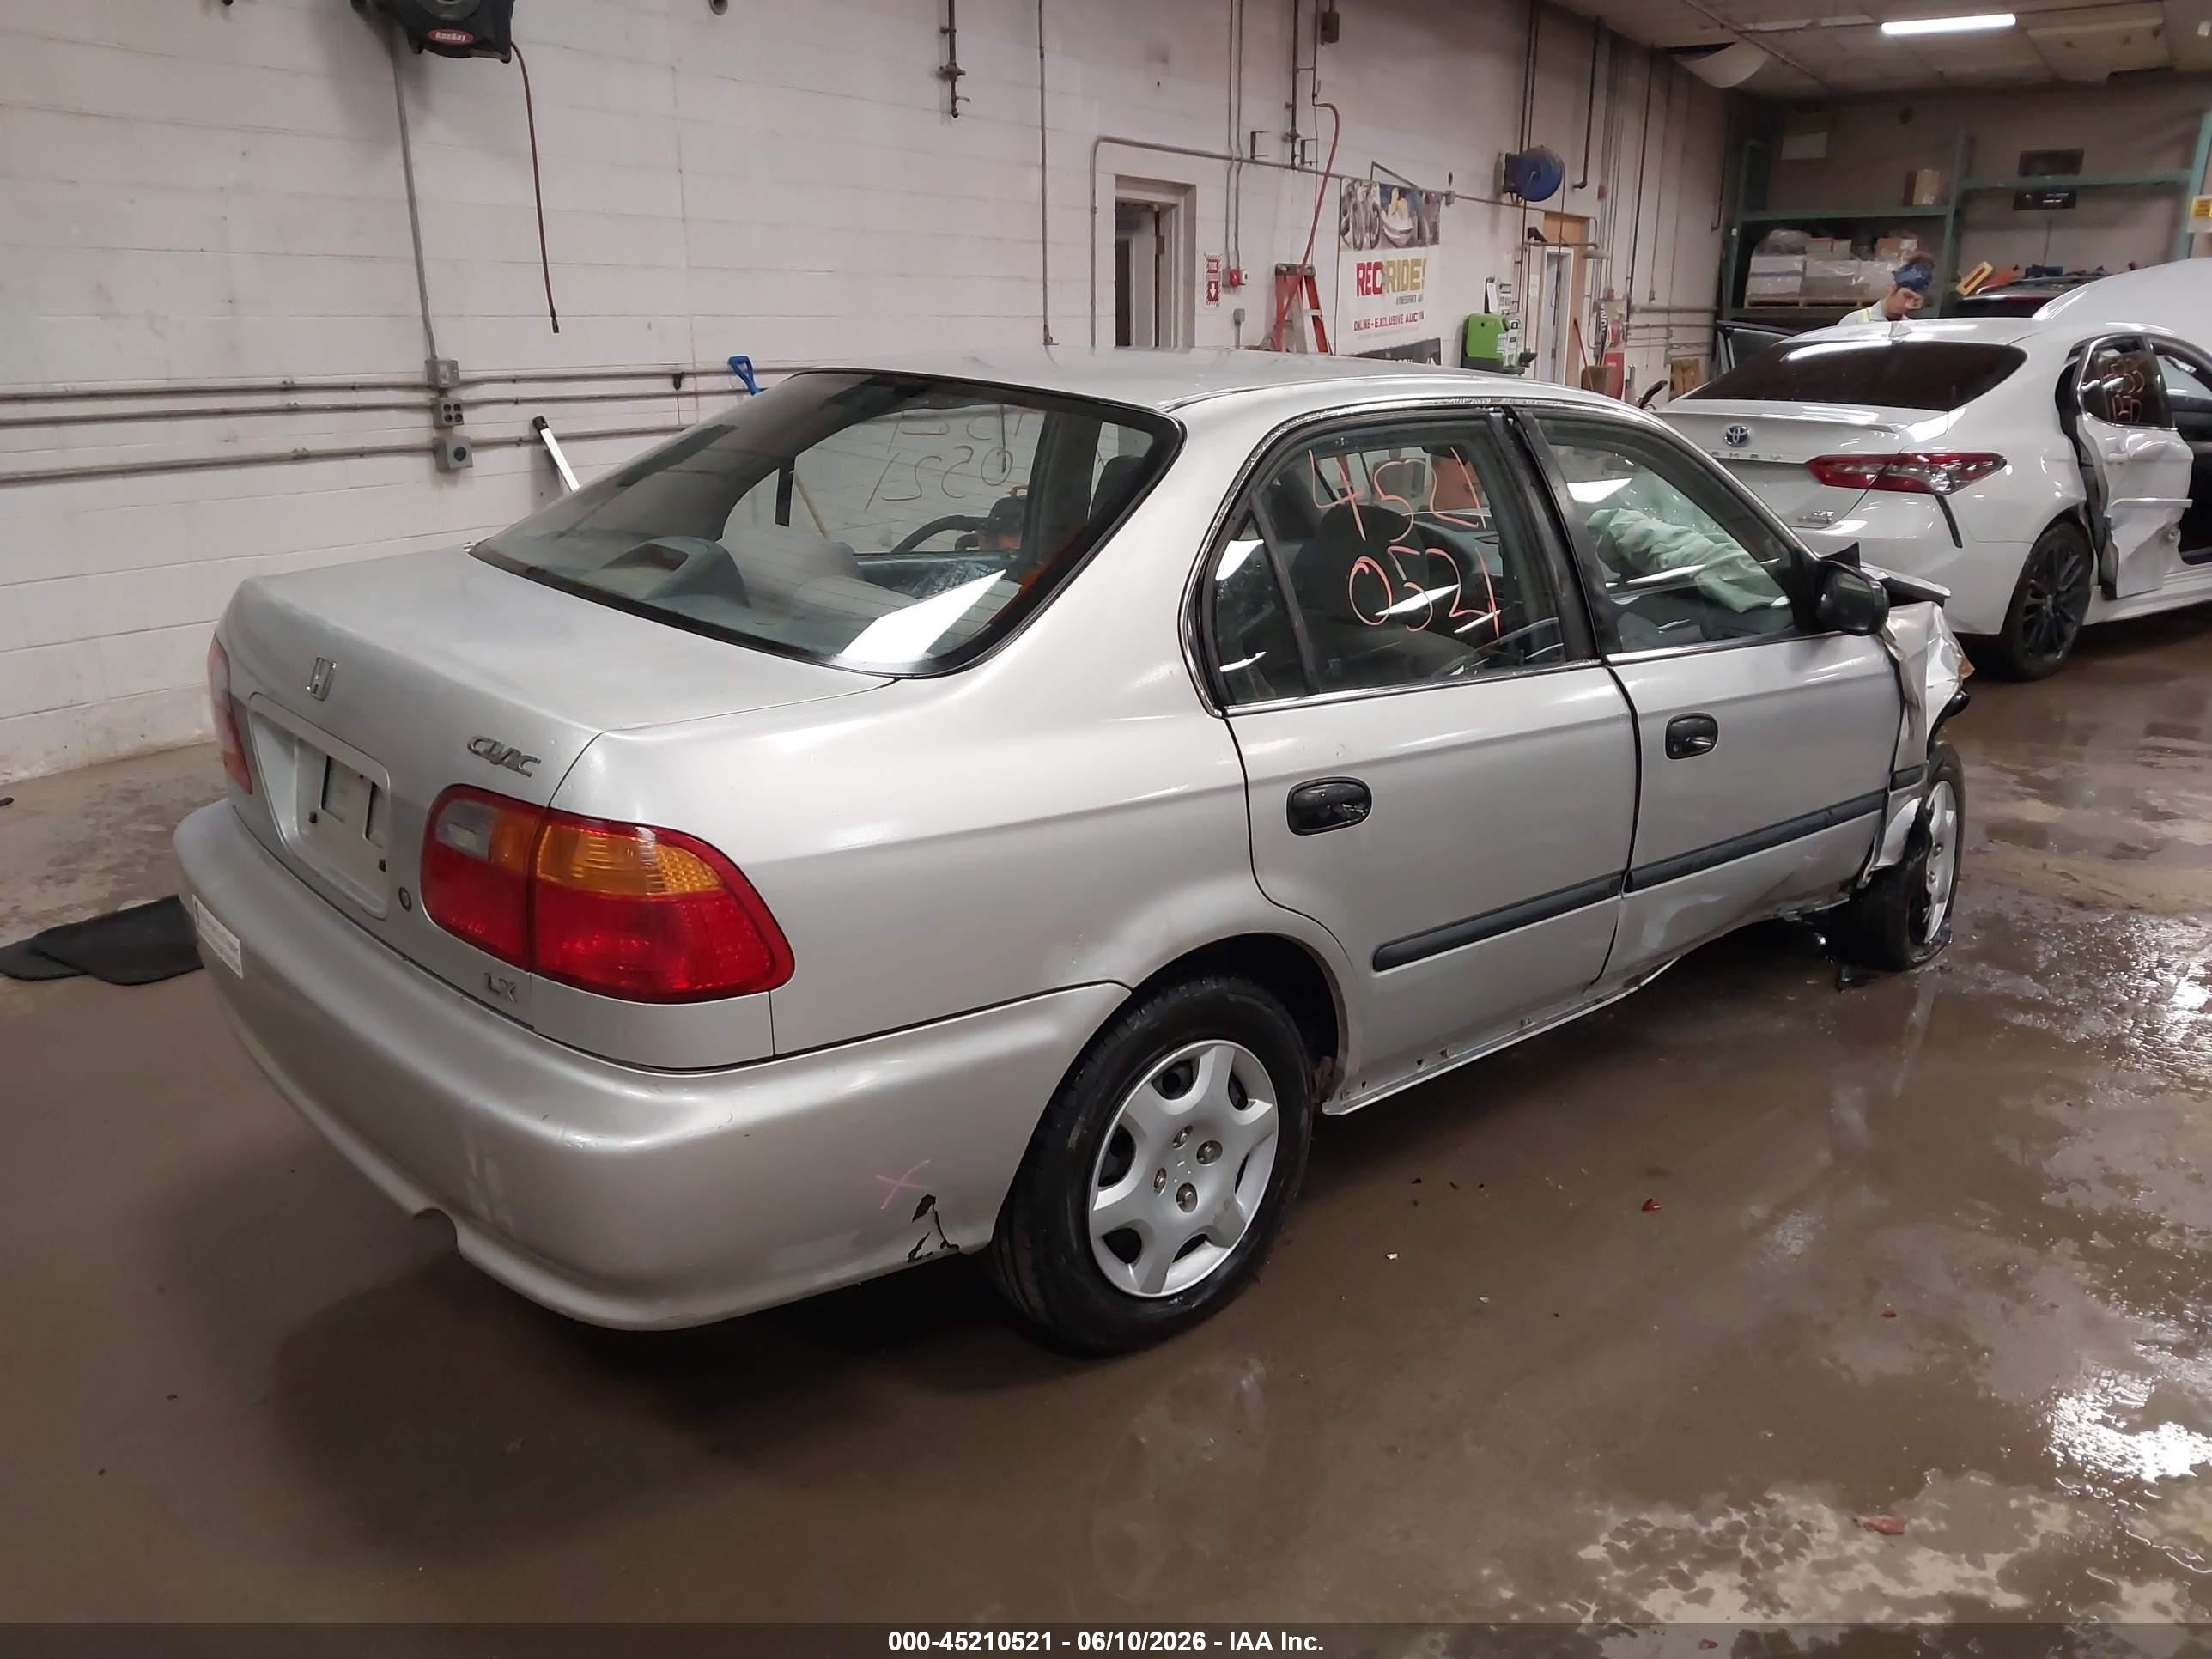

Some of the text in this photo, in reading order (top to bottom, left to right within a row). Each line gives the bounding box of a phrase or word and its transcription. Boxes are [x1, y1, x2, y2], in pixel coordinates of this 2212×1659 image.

[1308, 447, 1486, 543] 4521
[1348, 544, 1501, 639] 0521
[483, 971, 518, 1003] LX
